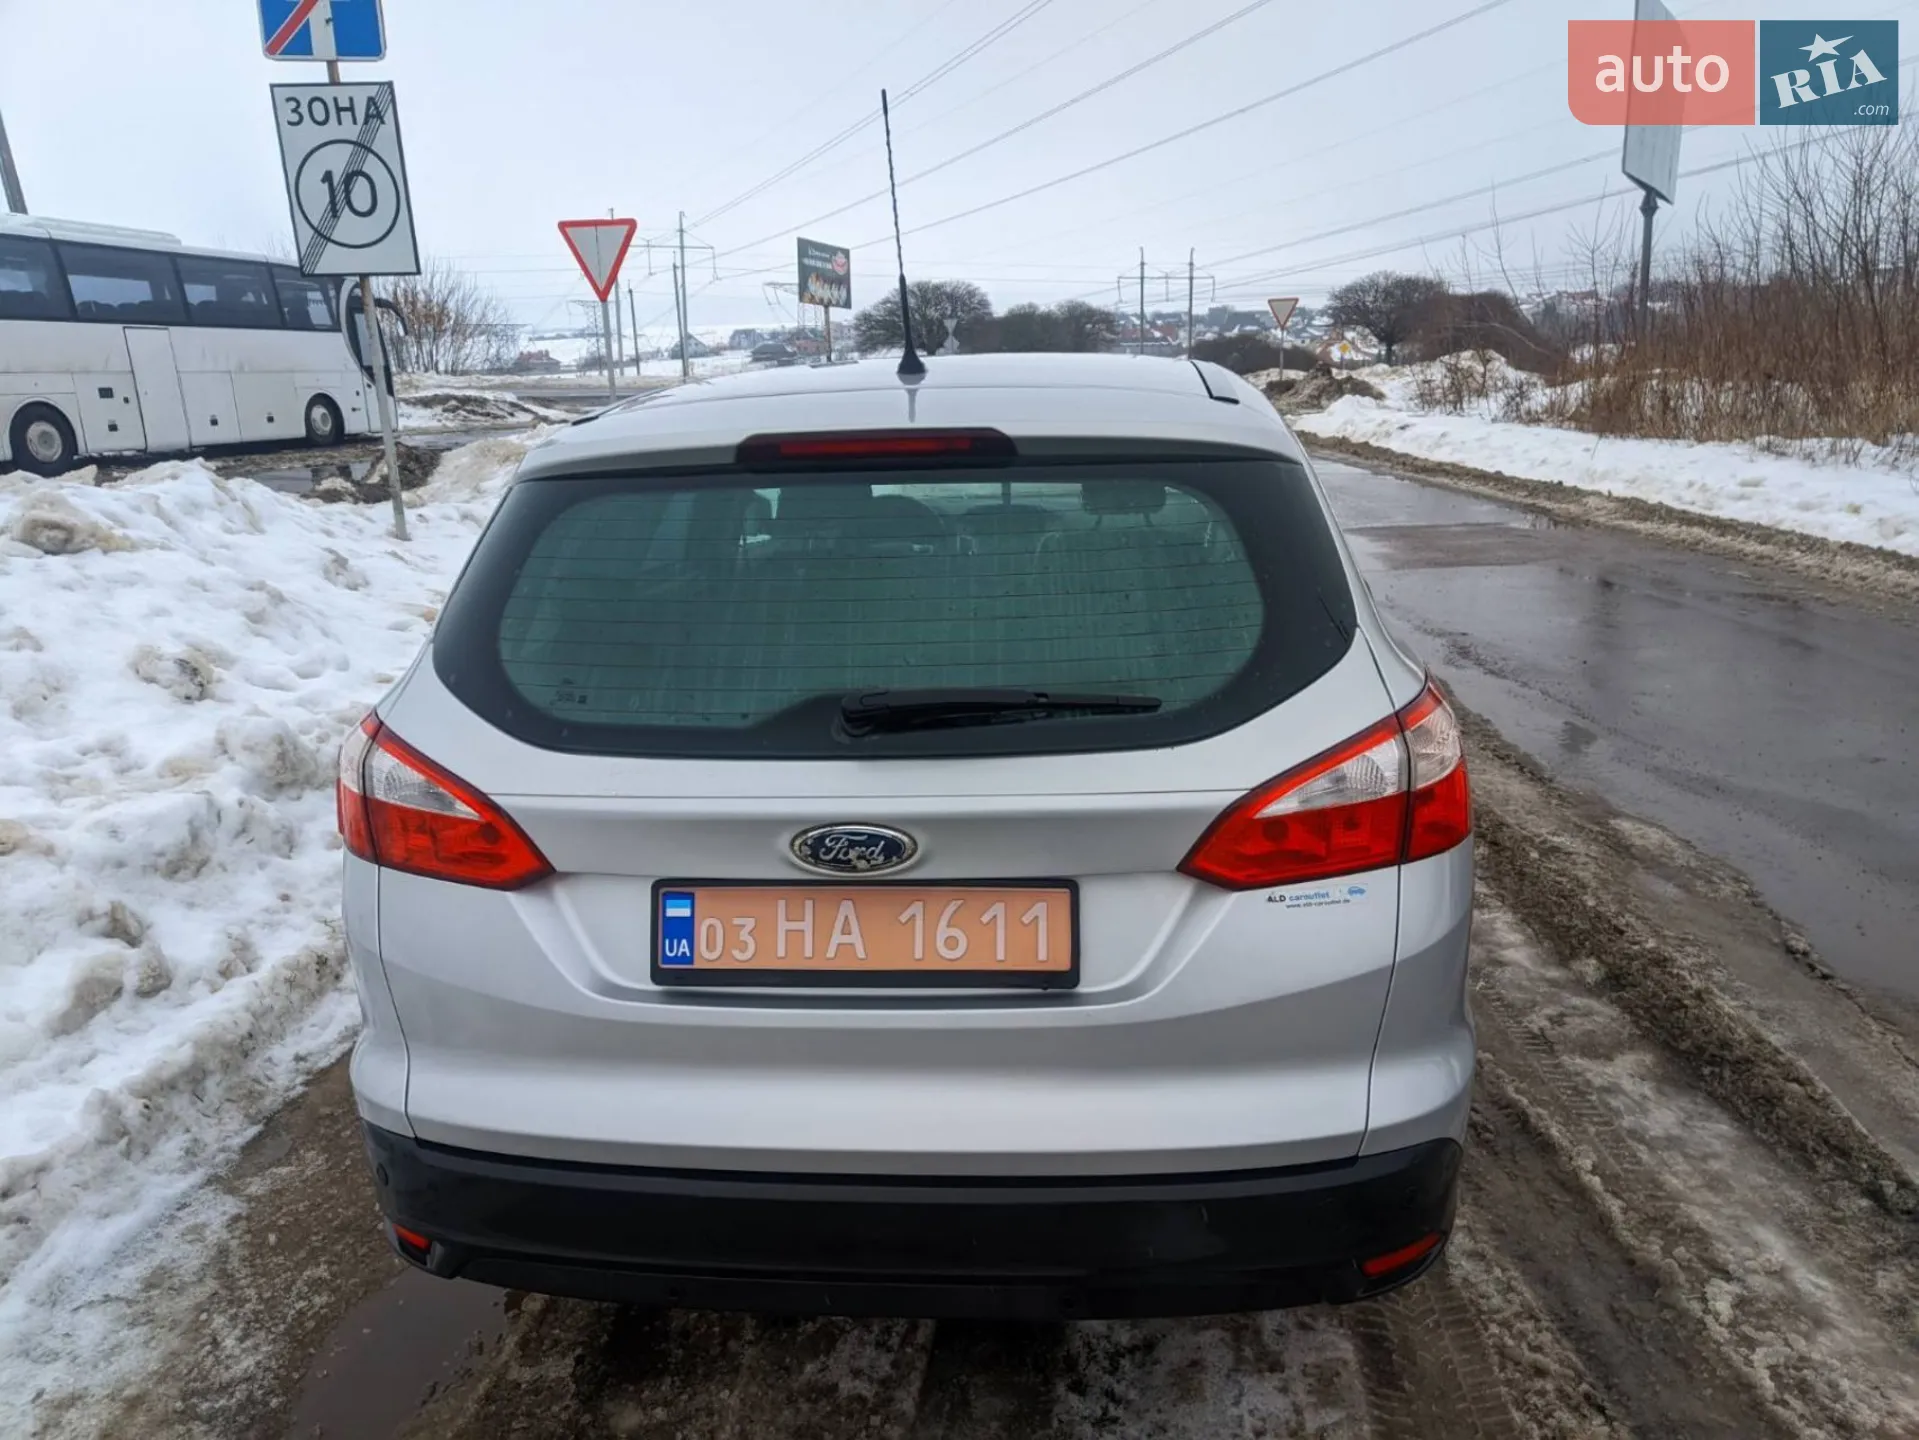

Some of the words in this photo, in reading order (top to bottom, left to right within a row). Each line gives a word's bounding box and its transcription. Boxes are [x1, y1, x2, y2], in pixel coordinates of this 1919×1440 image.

[285, 95, 385, 126] ЗОНА
[320, 169, 378, 218] 10
[819, 833, 885, 861] Ford
[1267, 894, 1286, 903] ALD
[699, 918, 757, 961] 03
[777, 899, 867, 960] HA
[898, 900, 1049, 961] 1611
[665, 940, 690, 957] UA
